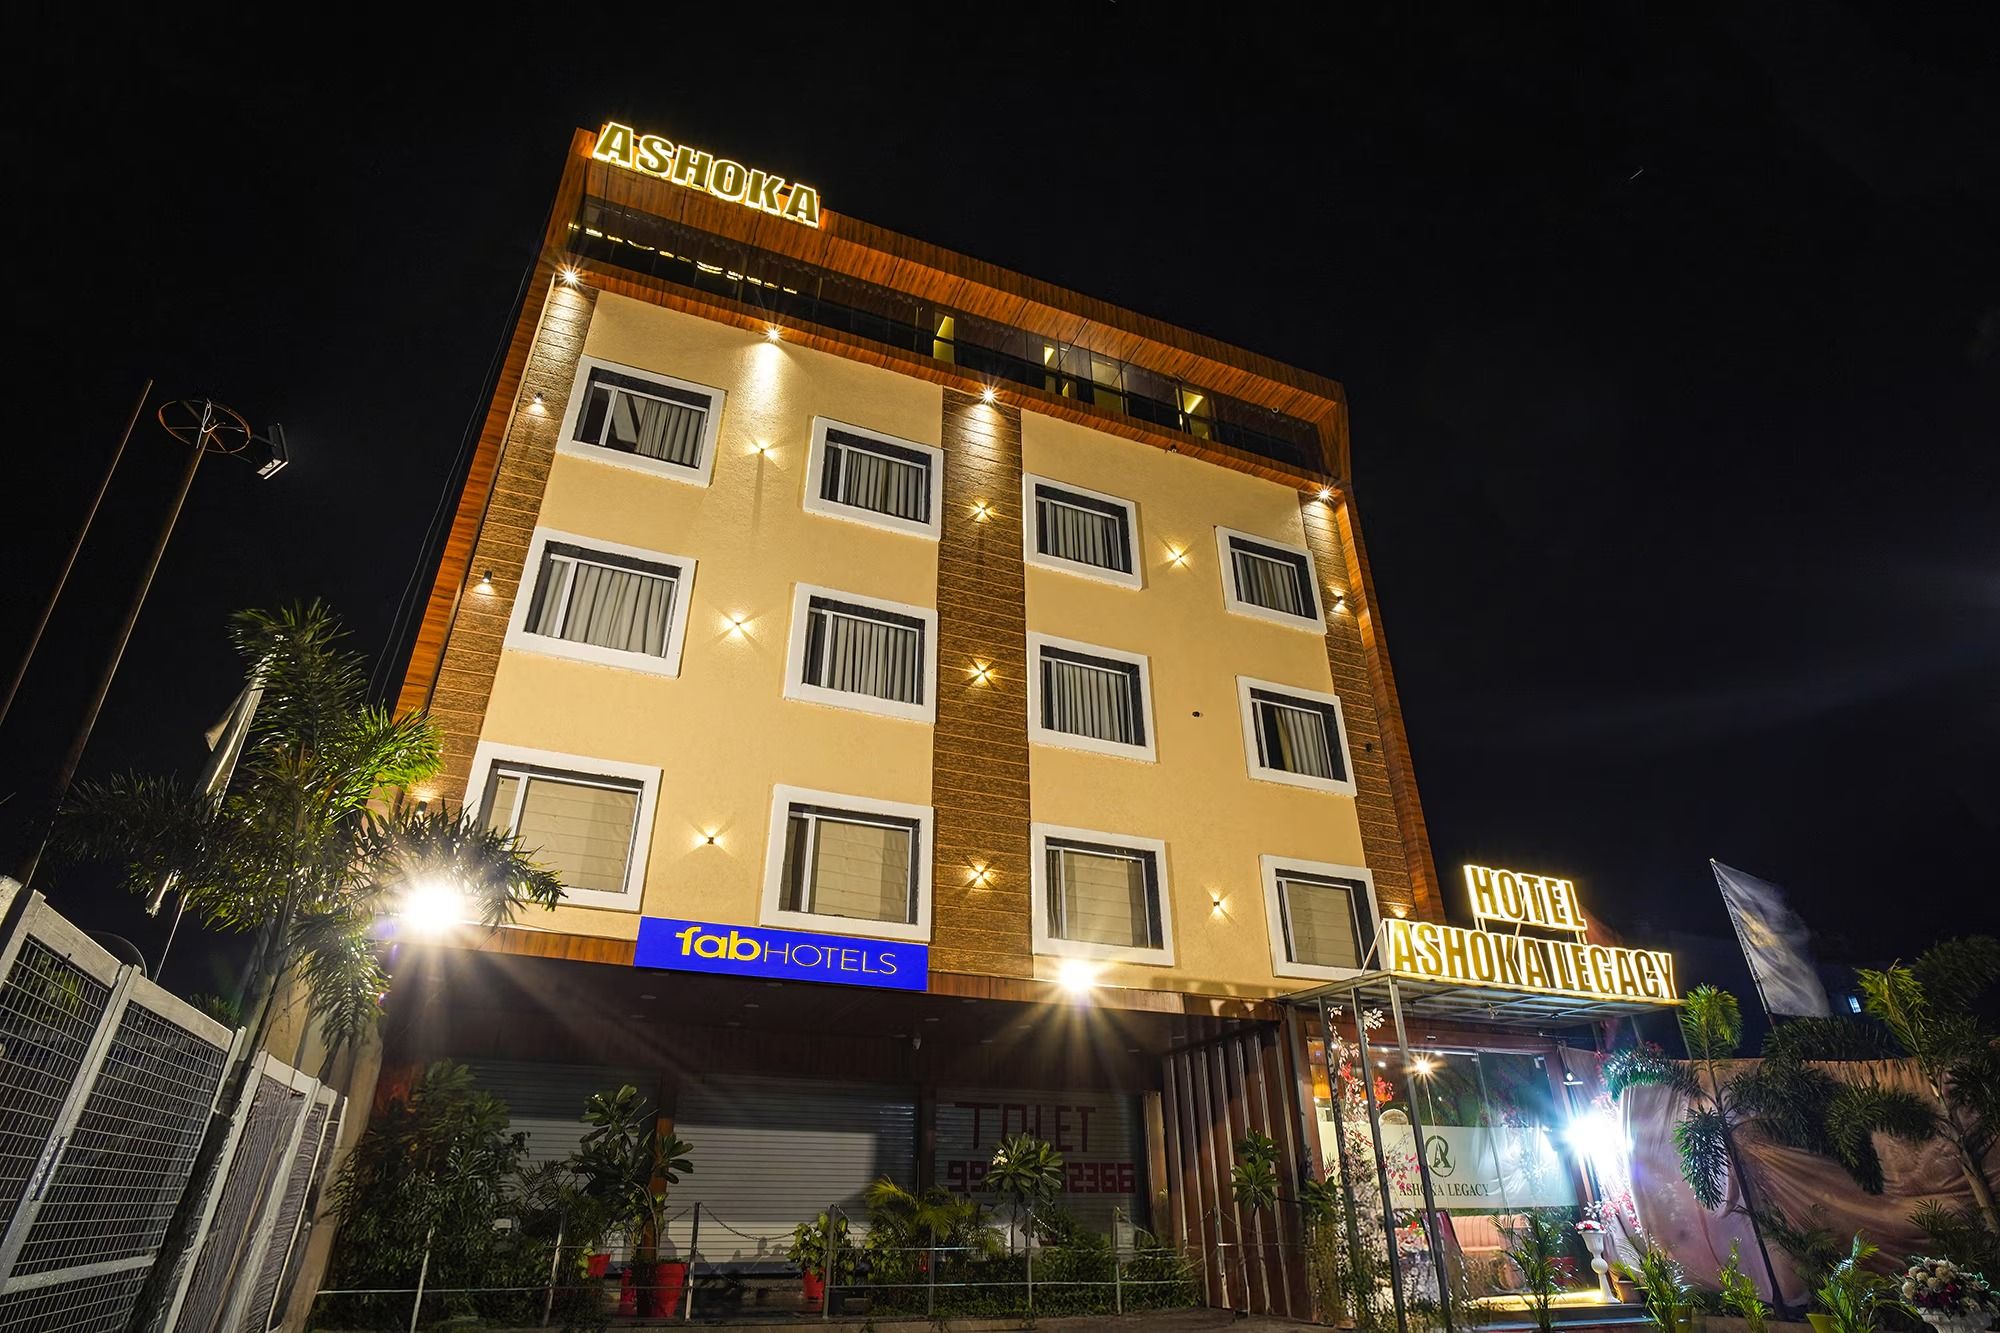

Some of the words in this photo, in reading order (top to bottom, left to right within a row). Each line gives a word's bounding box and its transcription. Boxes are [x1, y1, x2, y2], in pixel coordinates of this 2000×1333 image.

[592, 121, 820, 229] ASHOKA
[1464, 864, 1587, 931] HOTEL
[1388, 919, 1551, 989] ASHOKA
[1552, 939, 1679, 1000] LEGACY
[1447, 1183, 1489, 1197] LEGACY
